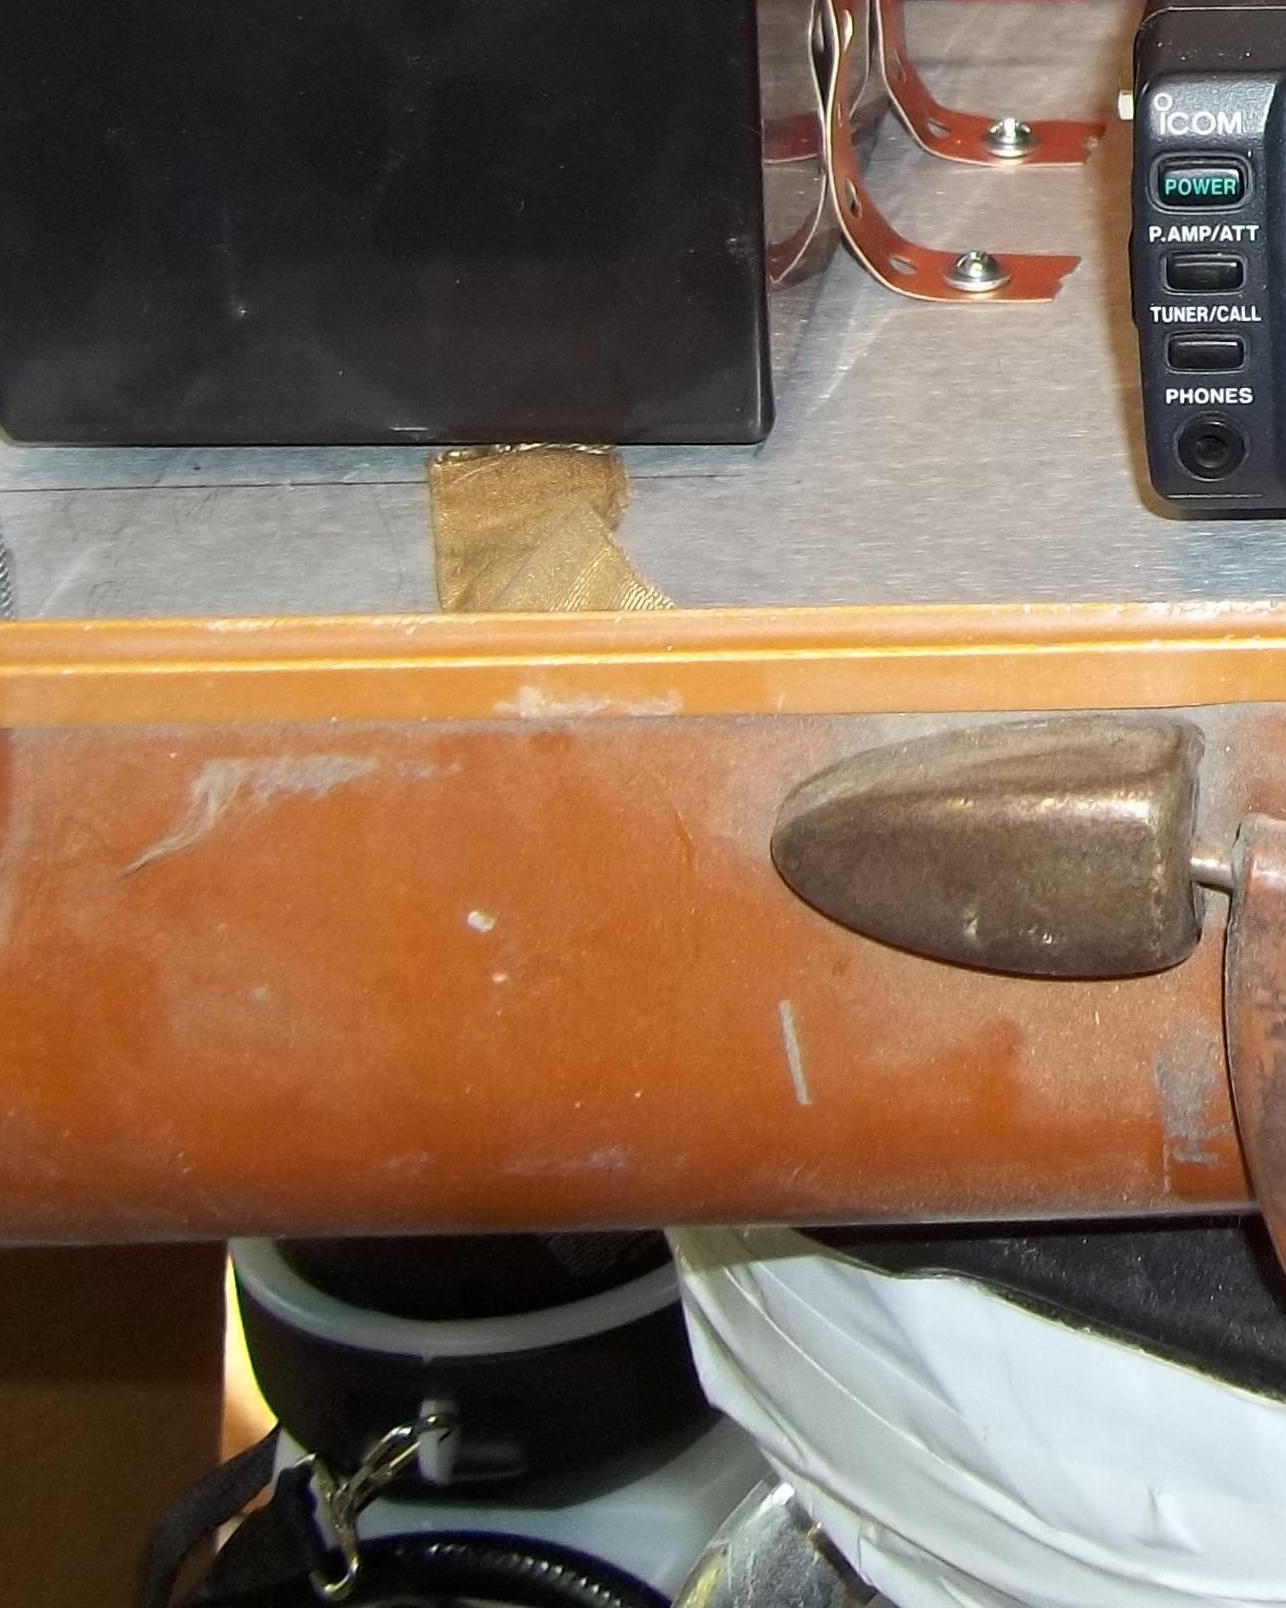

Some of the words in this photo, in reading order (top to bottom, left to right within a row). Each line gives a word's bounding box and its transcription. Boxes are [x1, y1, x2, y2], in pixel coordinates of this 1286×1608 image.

[1155, 106, 1243, 136] ICOM
[1165, 178, 1236, 196] POWER
[1150, 225, 1259, 242] P.AMP/ATT
[1150, 305, 1261, 323] TUNER/CALL
[1165, 388, 1253, 404] PHONES
